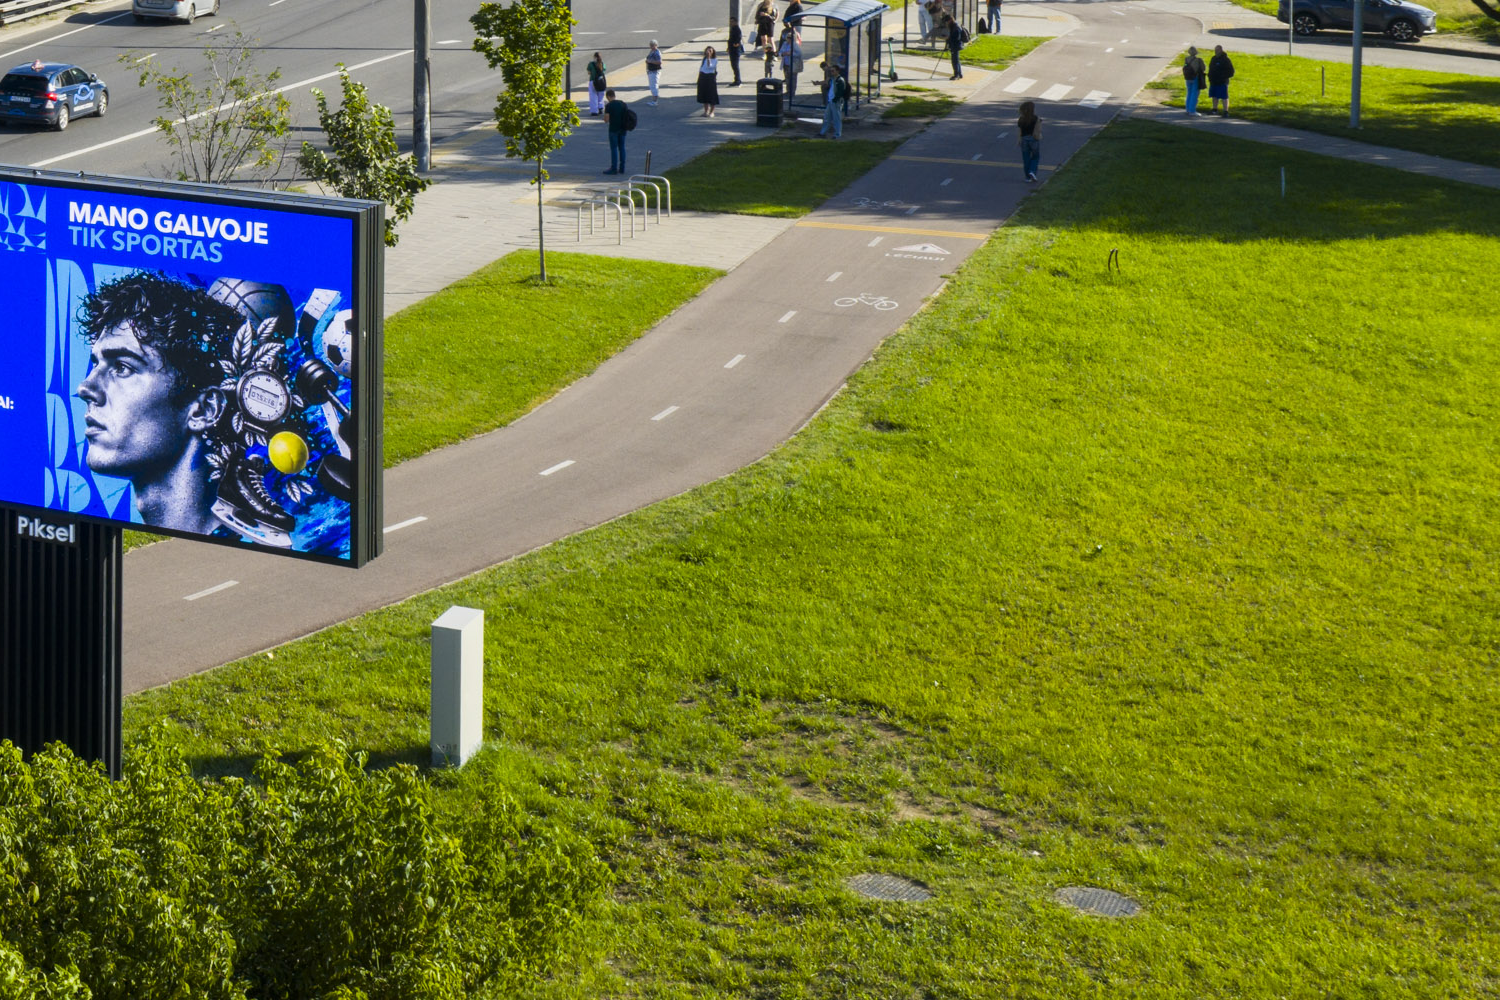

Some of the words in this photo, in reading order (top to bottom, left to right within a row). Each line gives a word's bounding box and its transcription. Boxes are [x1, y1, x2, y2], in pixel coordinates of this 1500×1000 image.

[69, 201, 149, 230] MANO
[154, 211, 269, 244] GALVOJE
[68, 225, 106, 249] TIK
[112, 230, 223, 263] SPORTAS
[17, 515, 76, 543] Piksel
